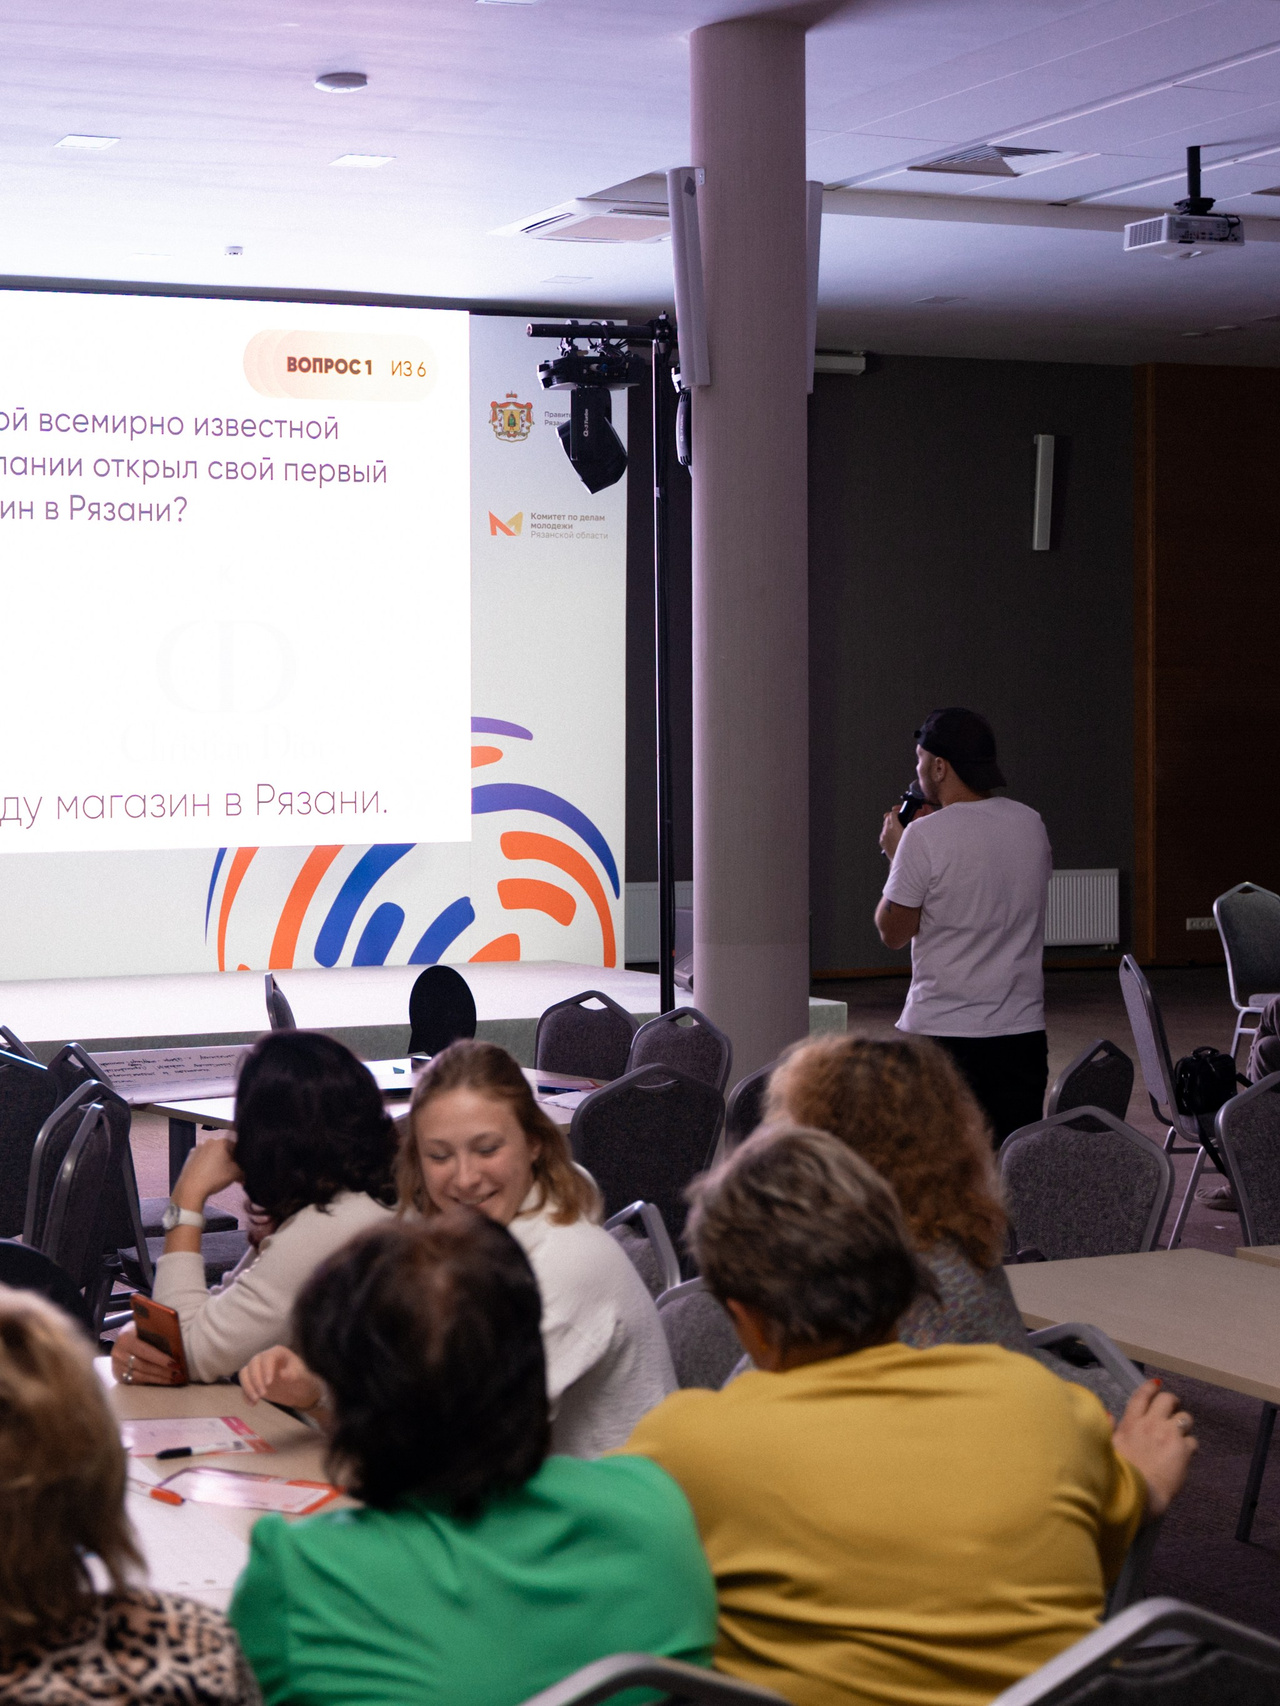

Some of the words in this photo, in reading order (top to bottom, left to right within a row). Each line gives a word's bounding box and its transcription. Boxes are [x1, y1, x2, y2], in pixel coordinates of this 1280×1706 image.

[286, 356, 361, 375] ВОПРОС
[364, 359, 372, 376] 1
[391, 360, 413, 377] ИЗ
[417, 361, 427, 377] 6
[40, 413, 184, 441] всемирно
[195, 416, 338, 440] известной
[93, 458, 197, 485] открыл
[208, 457, 273, 480] свой
[285, 460, 386, 489] первый
[45, 501, 59, 520] в
[70, 494, 187, 522] Рязани?
[531, 512, 566, 520] Комитет
[58, 794, 210, 820] магазин
[226, 793, 242, 816] в
[257, 784, 387, 817] Рязани.
